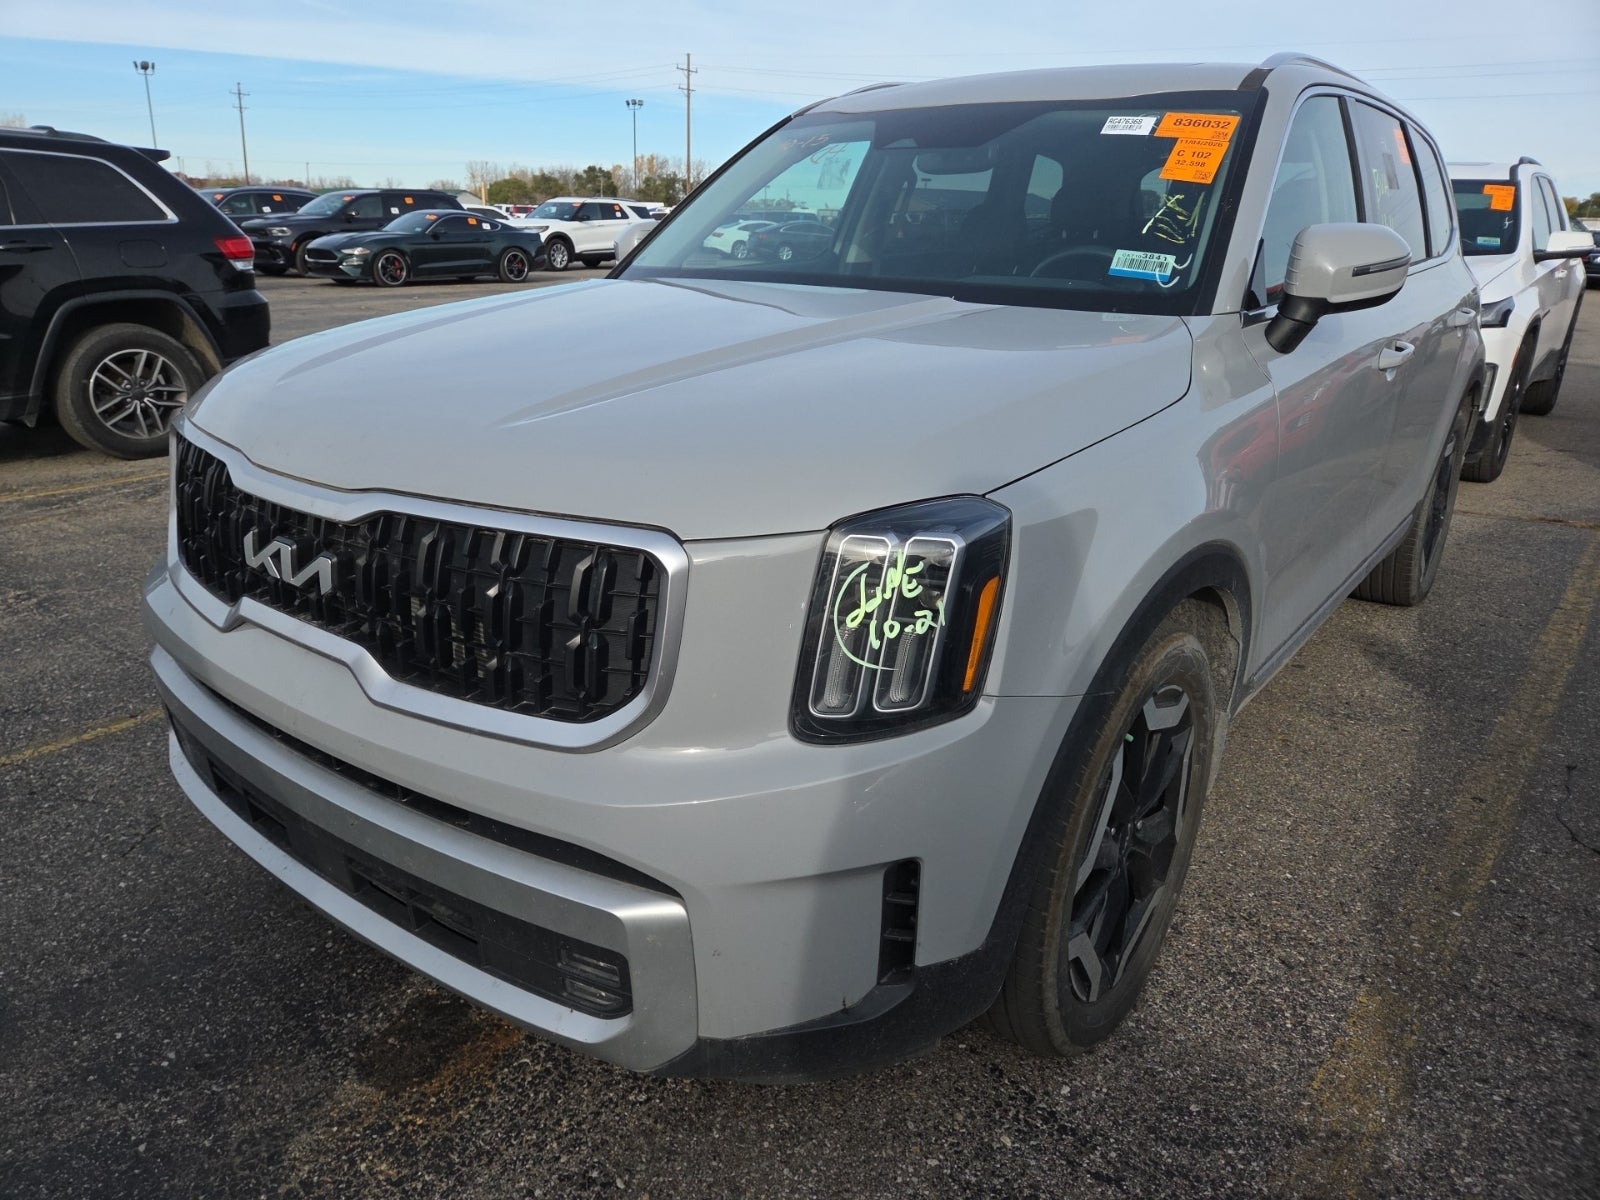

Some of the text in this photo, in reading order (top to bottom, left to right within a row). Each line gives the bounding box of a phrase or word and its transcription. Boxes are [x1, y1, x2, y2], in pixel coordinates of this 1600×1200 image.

[1173, 118, 1231, 130] 836032
[1177, 149, 1212, 159] C 102
[243, 526, 337, 596] KIA
